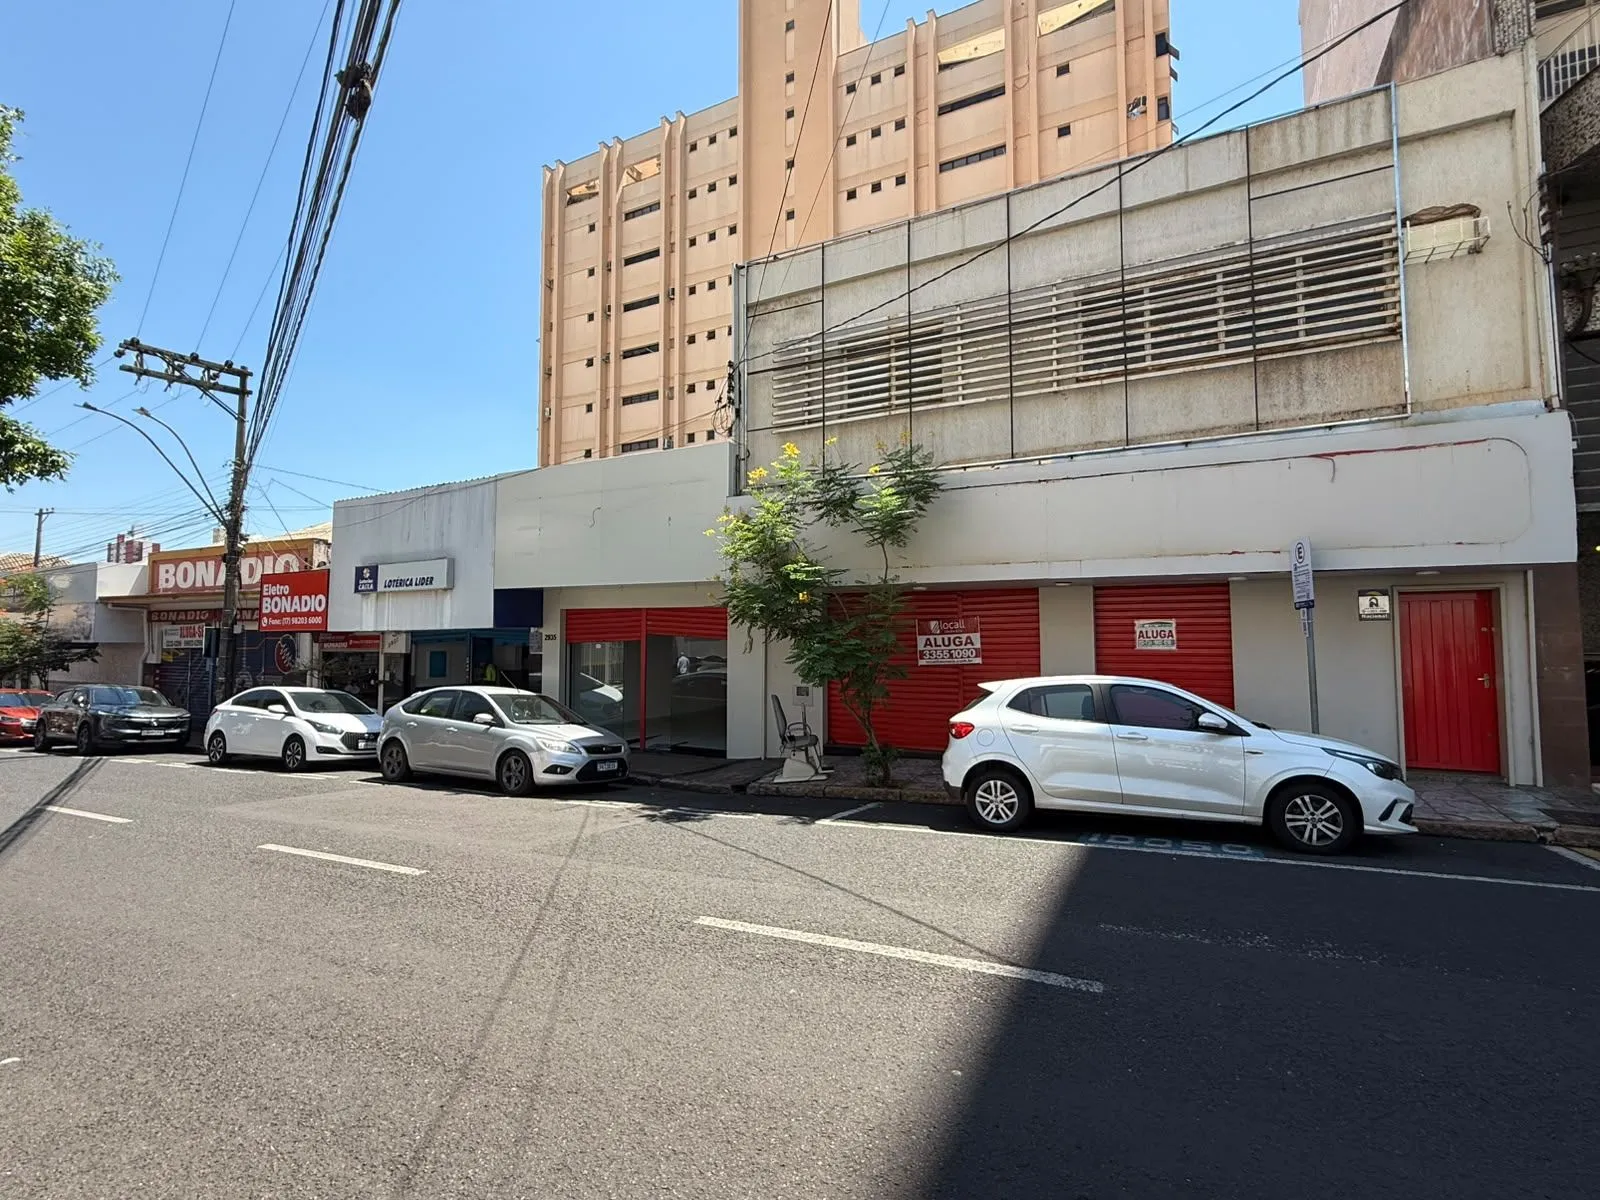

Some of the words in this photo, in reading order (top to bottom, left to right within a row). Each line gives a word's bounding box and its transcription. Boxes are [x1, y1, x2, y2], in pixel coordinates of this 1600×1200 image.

[1297, 547, 1303, 560] E
[384, 576, 413, 588] LOTÉRICA
[263, 584, 290, 596] Eletro
[262, 594, 326, 614] BONADIO
[152, 610, 209, 621] BONADIO
[939, 619, 965, 629] locall
[1138, 630, 1174, 639] ALUGA
[923, 635, 974, 648] ALUGA
[923, 649, 976, 659] 33551090
[1088, 833, 1253, 854] IDOSO
